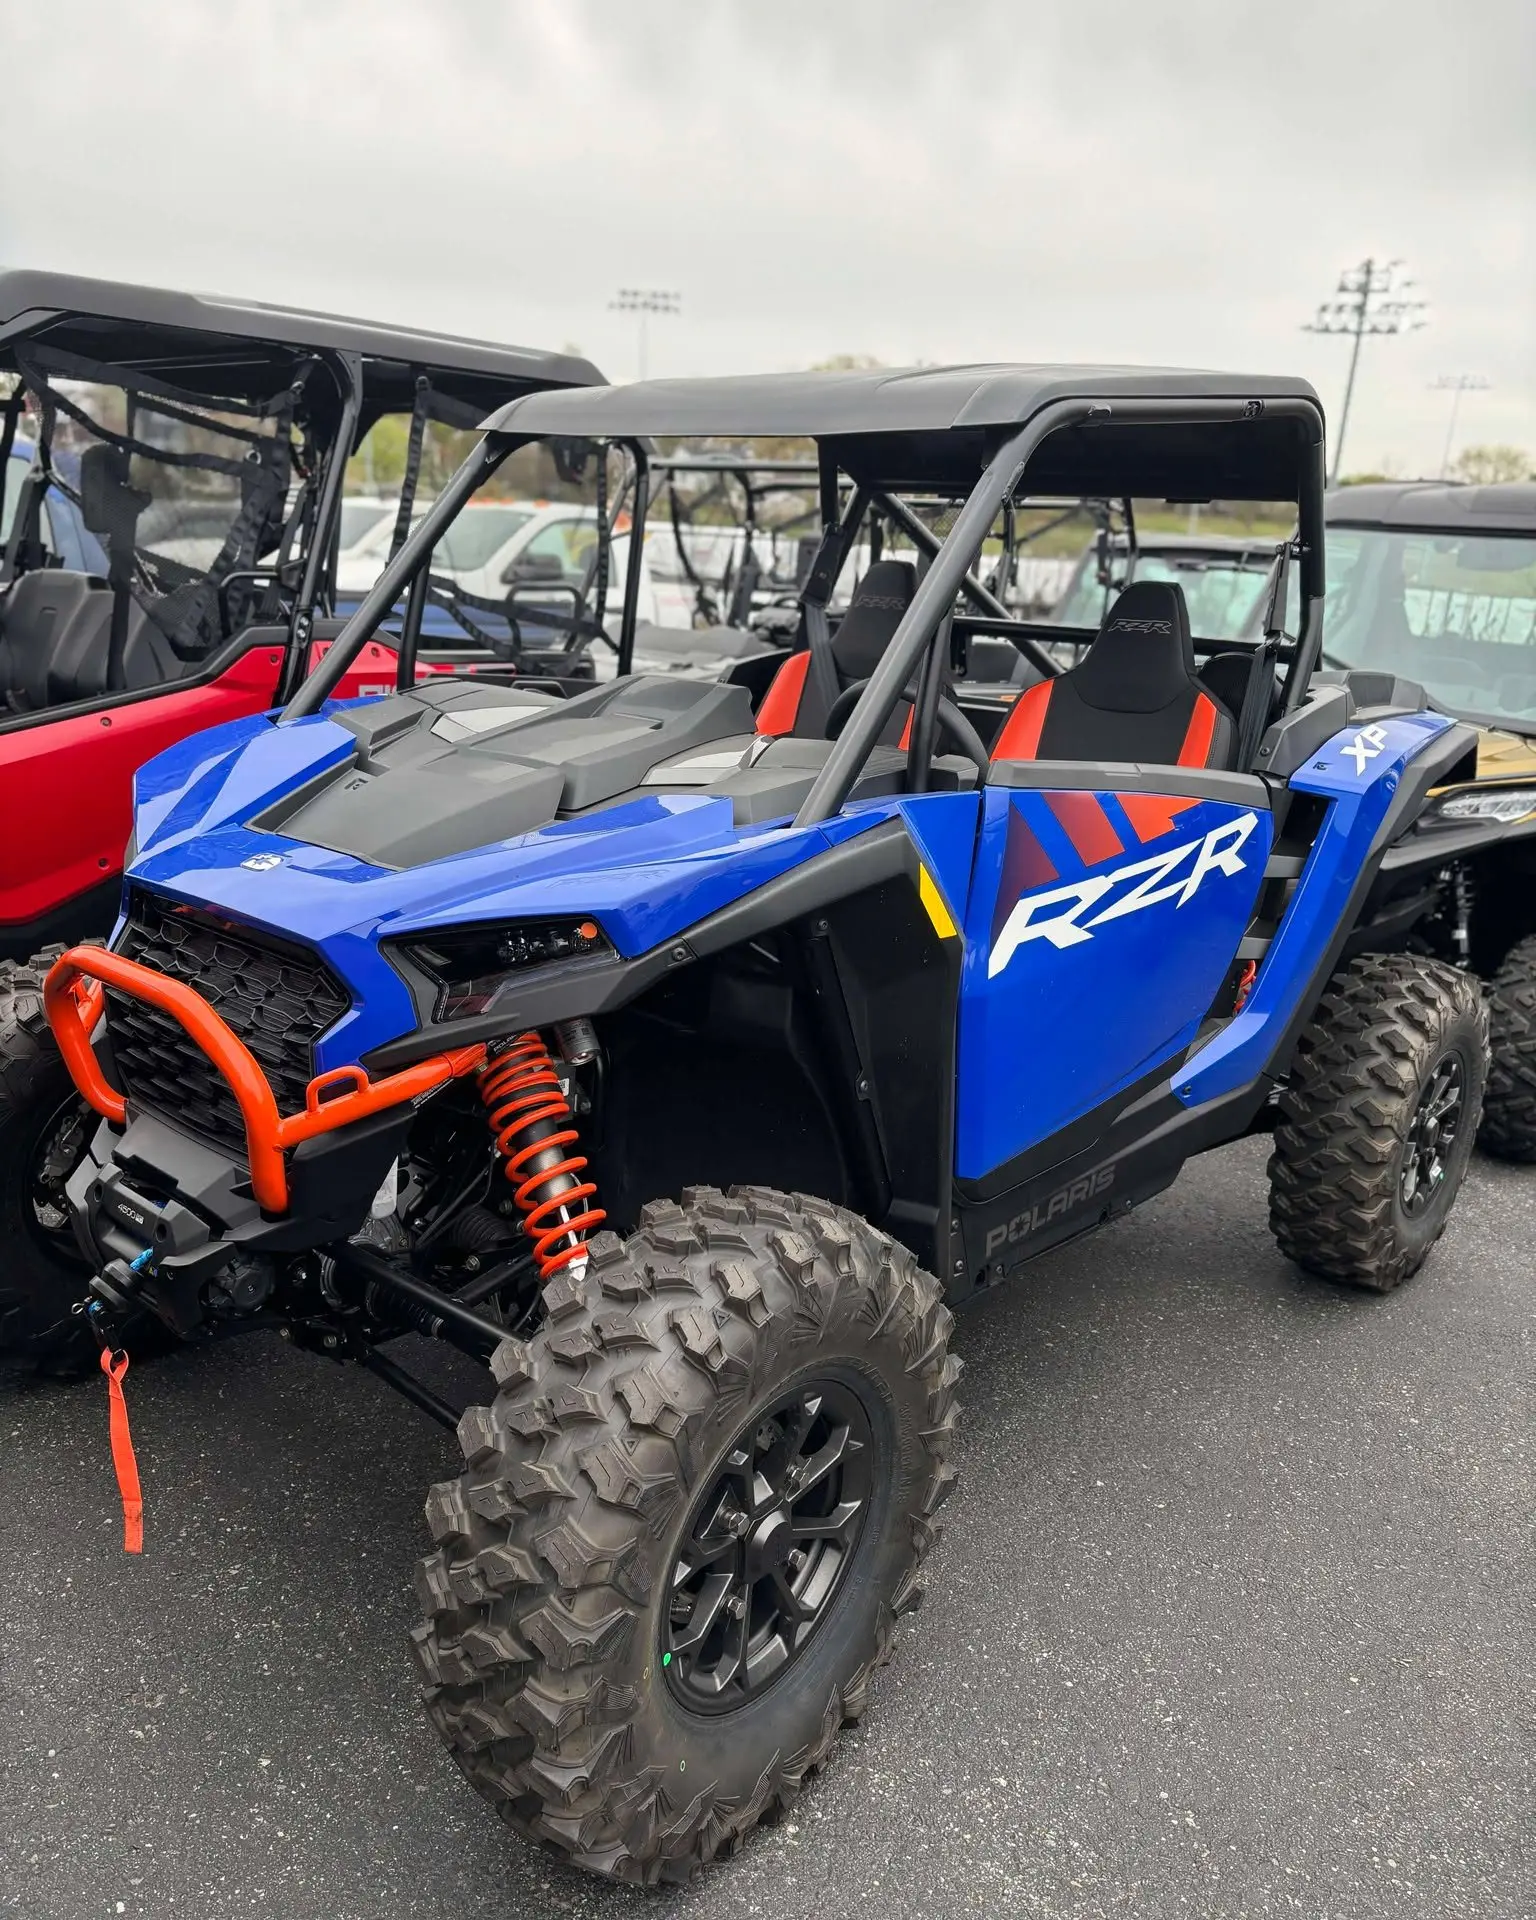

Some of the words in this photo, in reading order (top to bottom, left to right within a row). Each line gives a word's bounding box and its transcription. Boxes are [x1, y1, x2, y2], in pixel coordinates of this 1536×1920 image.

[1107, 618, 1172, 634] RZR
[1340, 724, 1388, 776] XP
[988, 812, 1259, 980] RZR
[985, 1164, 1117, 1258] POLARIS
